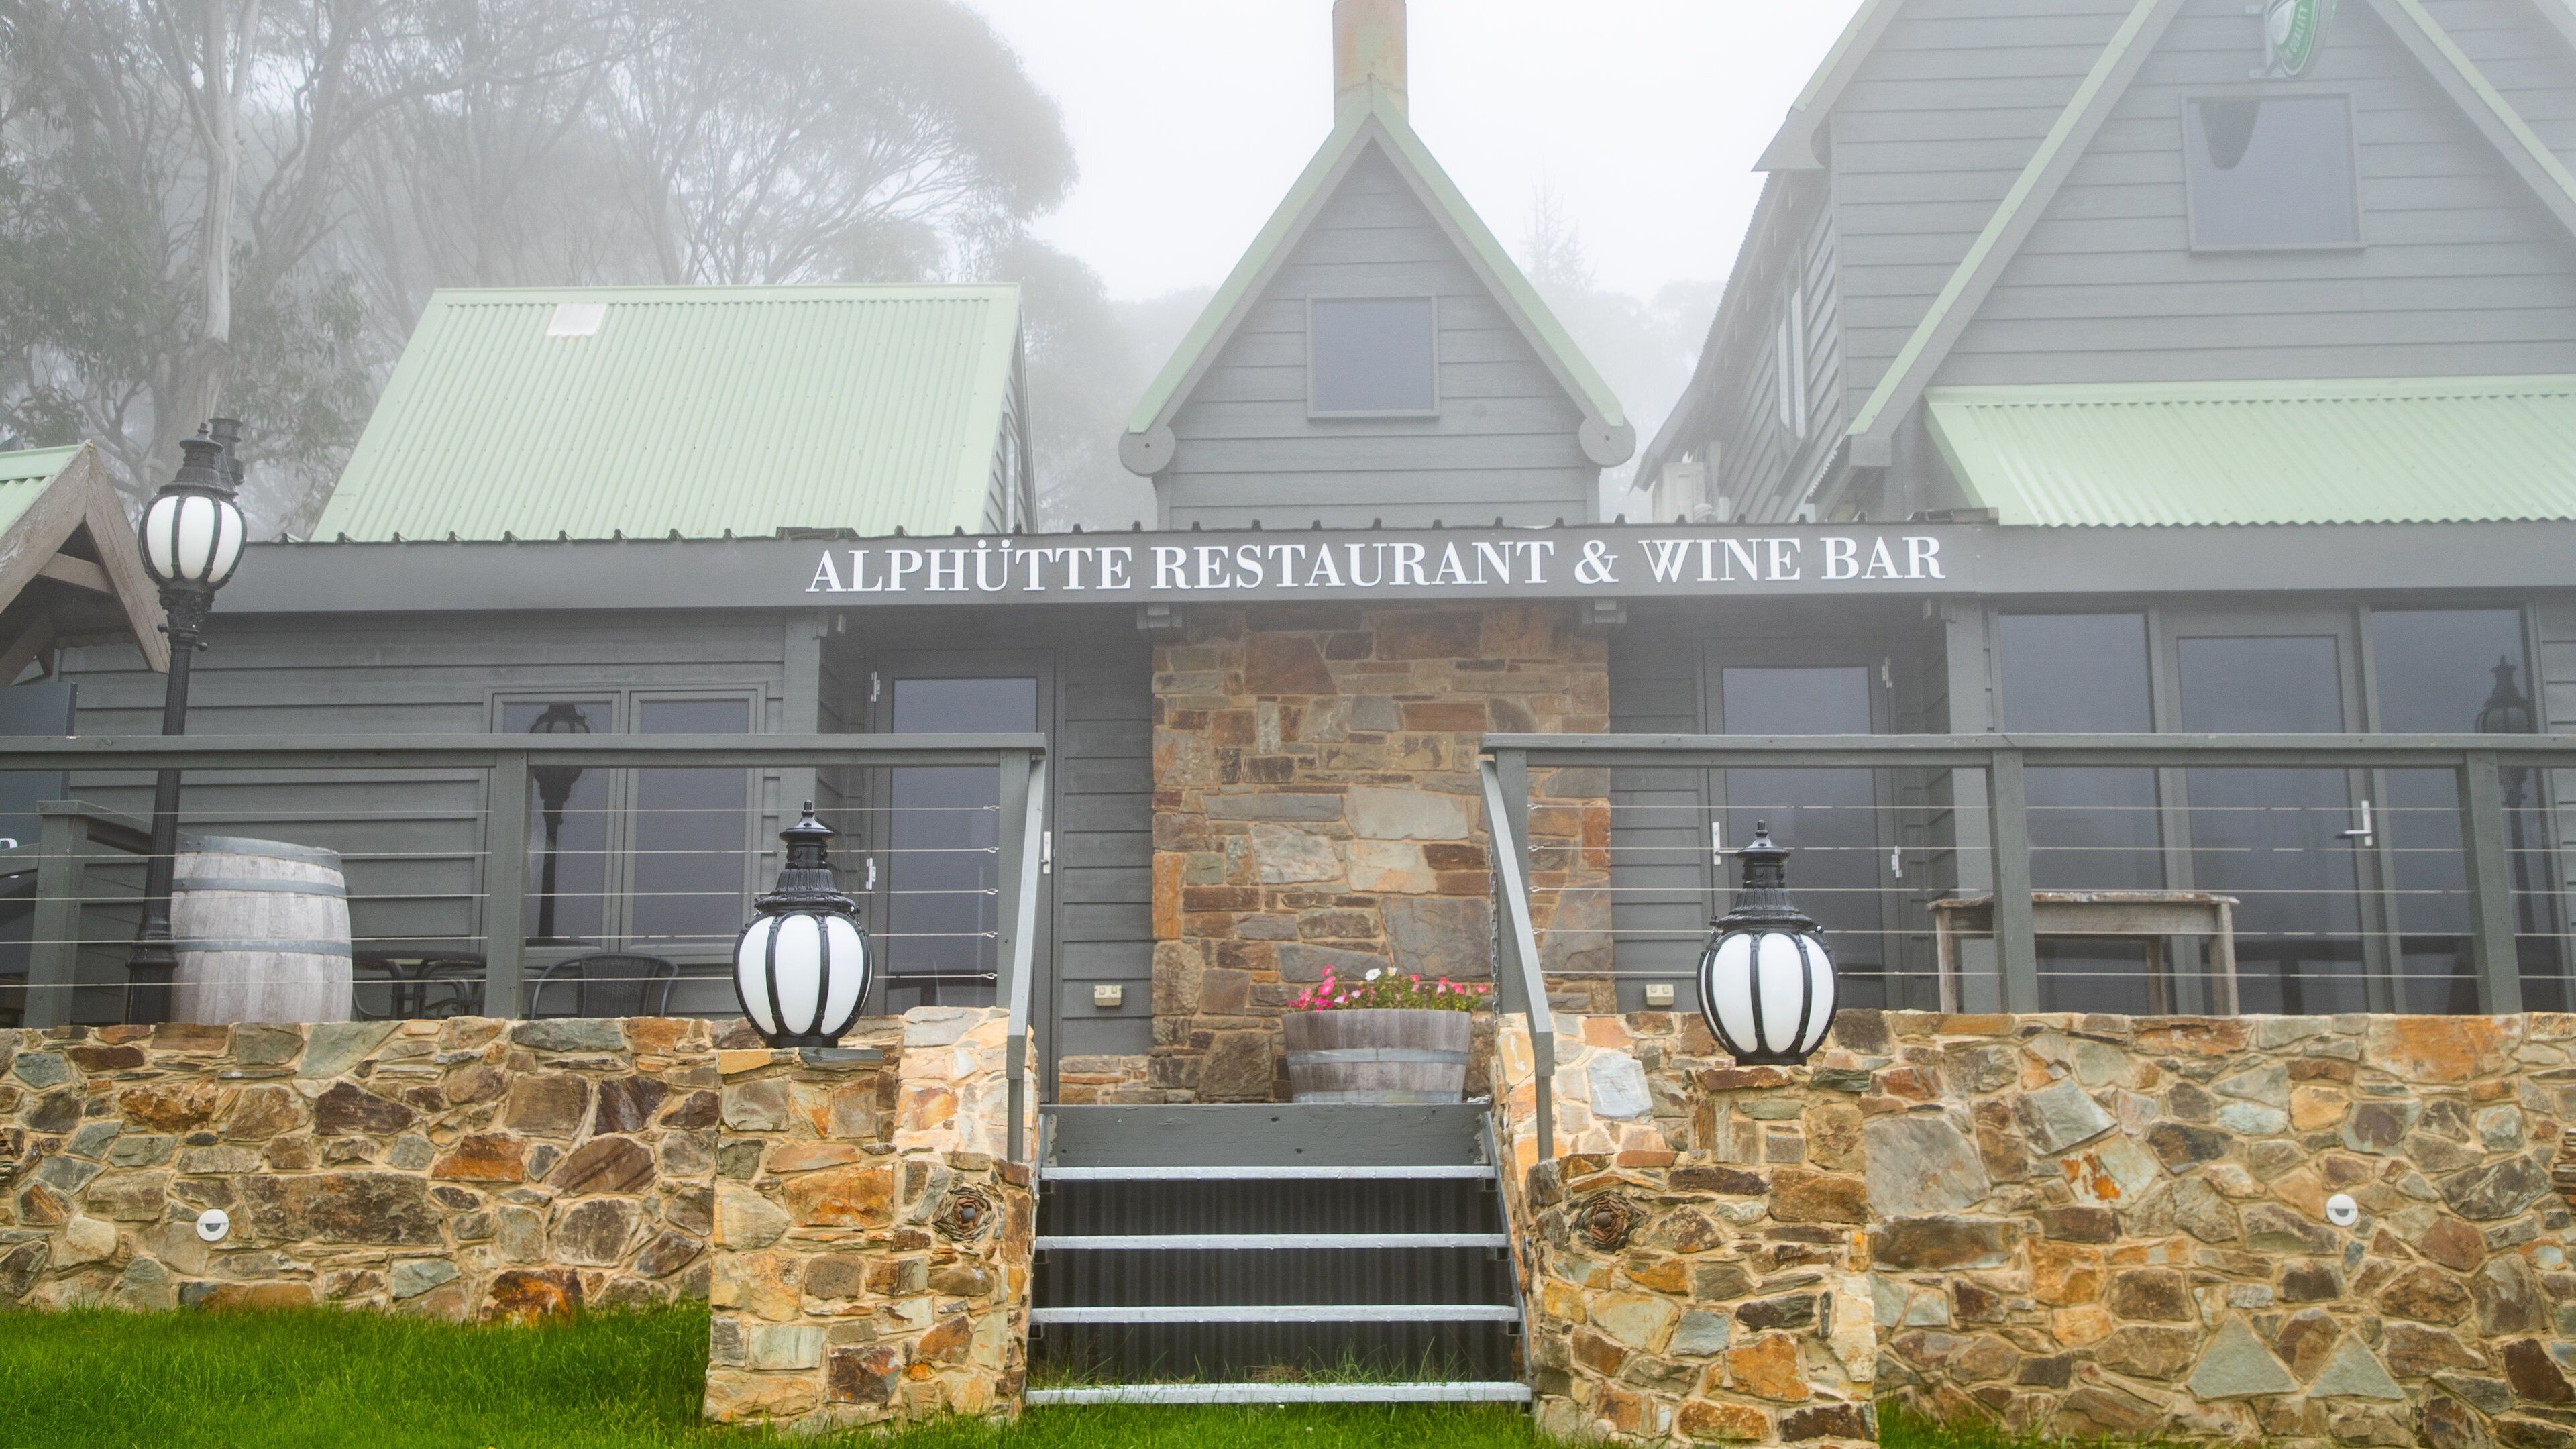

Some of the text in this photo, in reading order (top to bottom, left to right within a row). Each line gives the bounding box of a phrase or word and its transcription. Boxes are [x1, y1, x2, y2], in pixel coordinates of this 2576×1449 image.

[805, 536, 1946, 592] ALPHÜTTE RESTAURANT & WINE BAR
